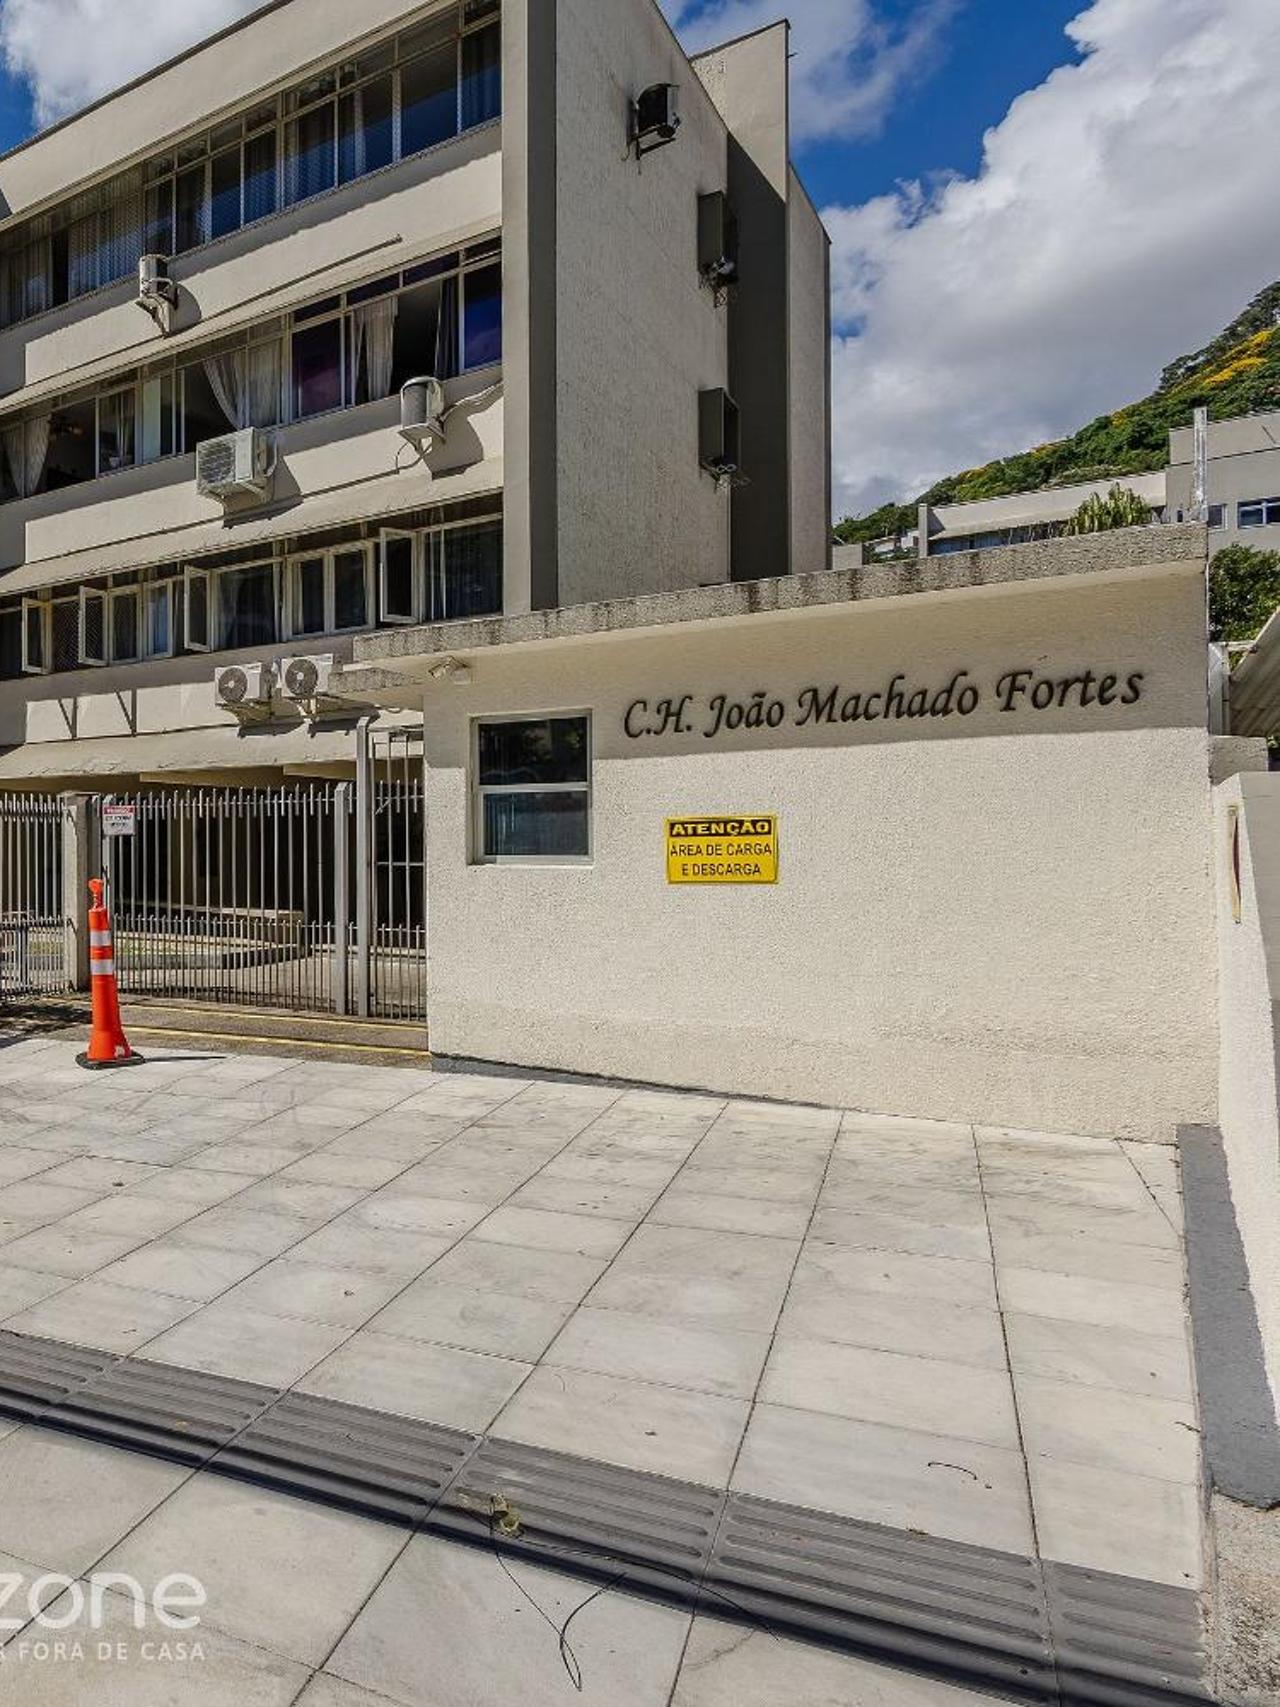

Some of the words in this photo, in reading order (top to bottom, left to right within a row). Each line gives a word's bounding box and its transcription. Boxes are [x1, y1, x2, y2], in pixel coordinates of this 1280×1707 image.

[623, 694, 693, 738] C.H.
[703, 691, 785, 738] João
[795, 670, 979, 727] Machado
[995, 669, 1144, 713] Fortes
[671, 820, 770, 836] ATENÇÃO
[706, 844, 723, 856] DE
[726, 842, 772, 856] CARGA
[681, 863, 689, 876] E
[692, 863, 762, 876] DESCARGA
